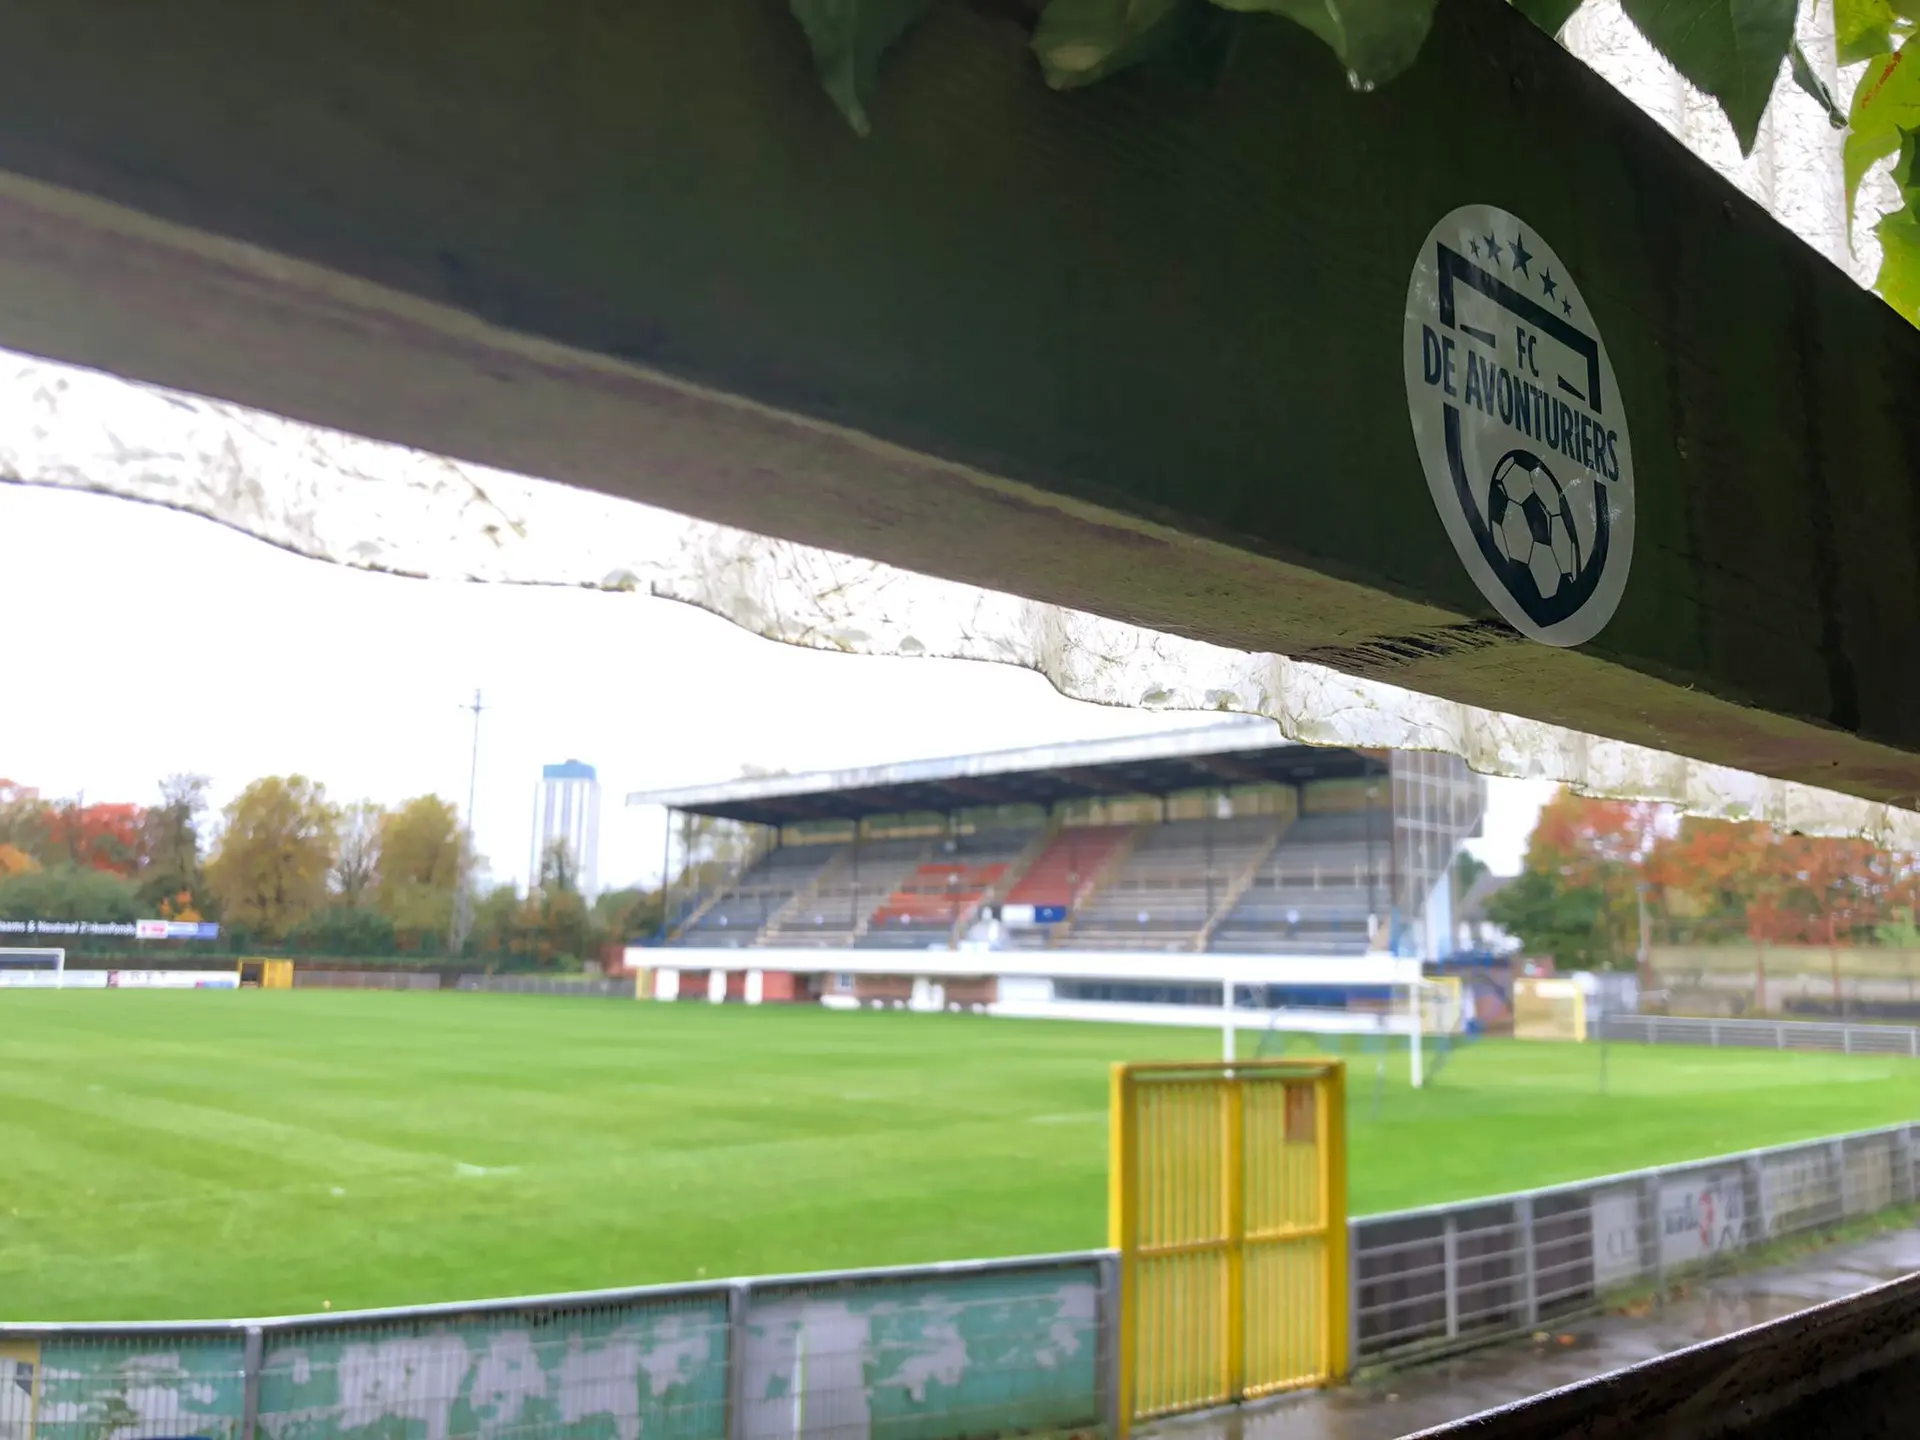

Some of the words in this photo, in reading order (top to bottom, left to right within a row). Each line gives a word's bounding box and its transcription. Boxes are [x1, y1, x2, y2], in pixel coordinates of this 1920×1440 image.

[1422, 323, 1457, 397] DE
[1465, 349, 1619, 482] AVONTURIERS
[1516, 325, 1539, 378] FC
